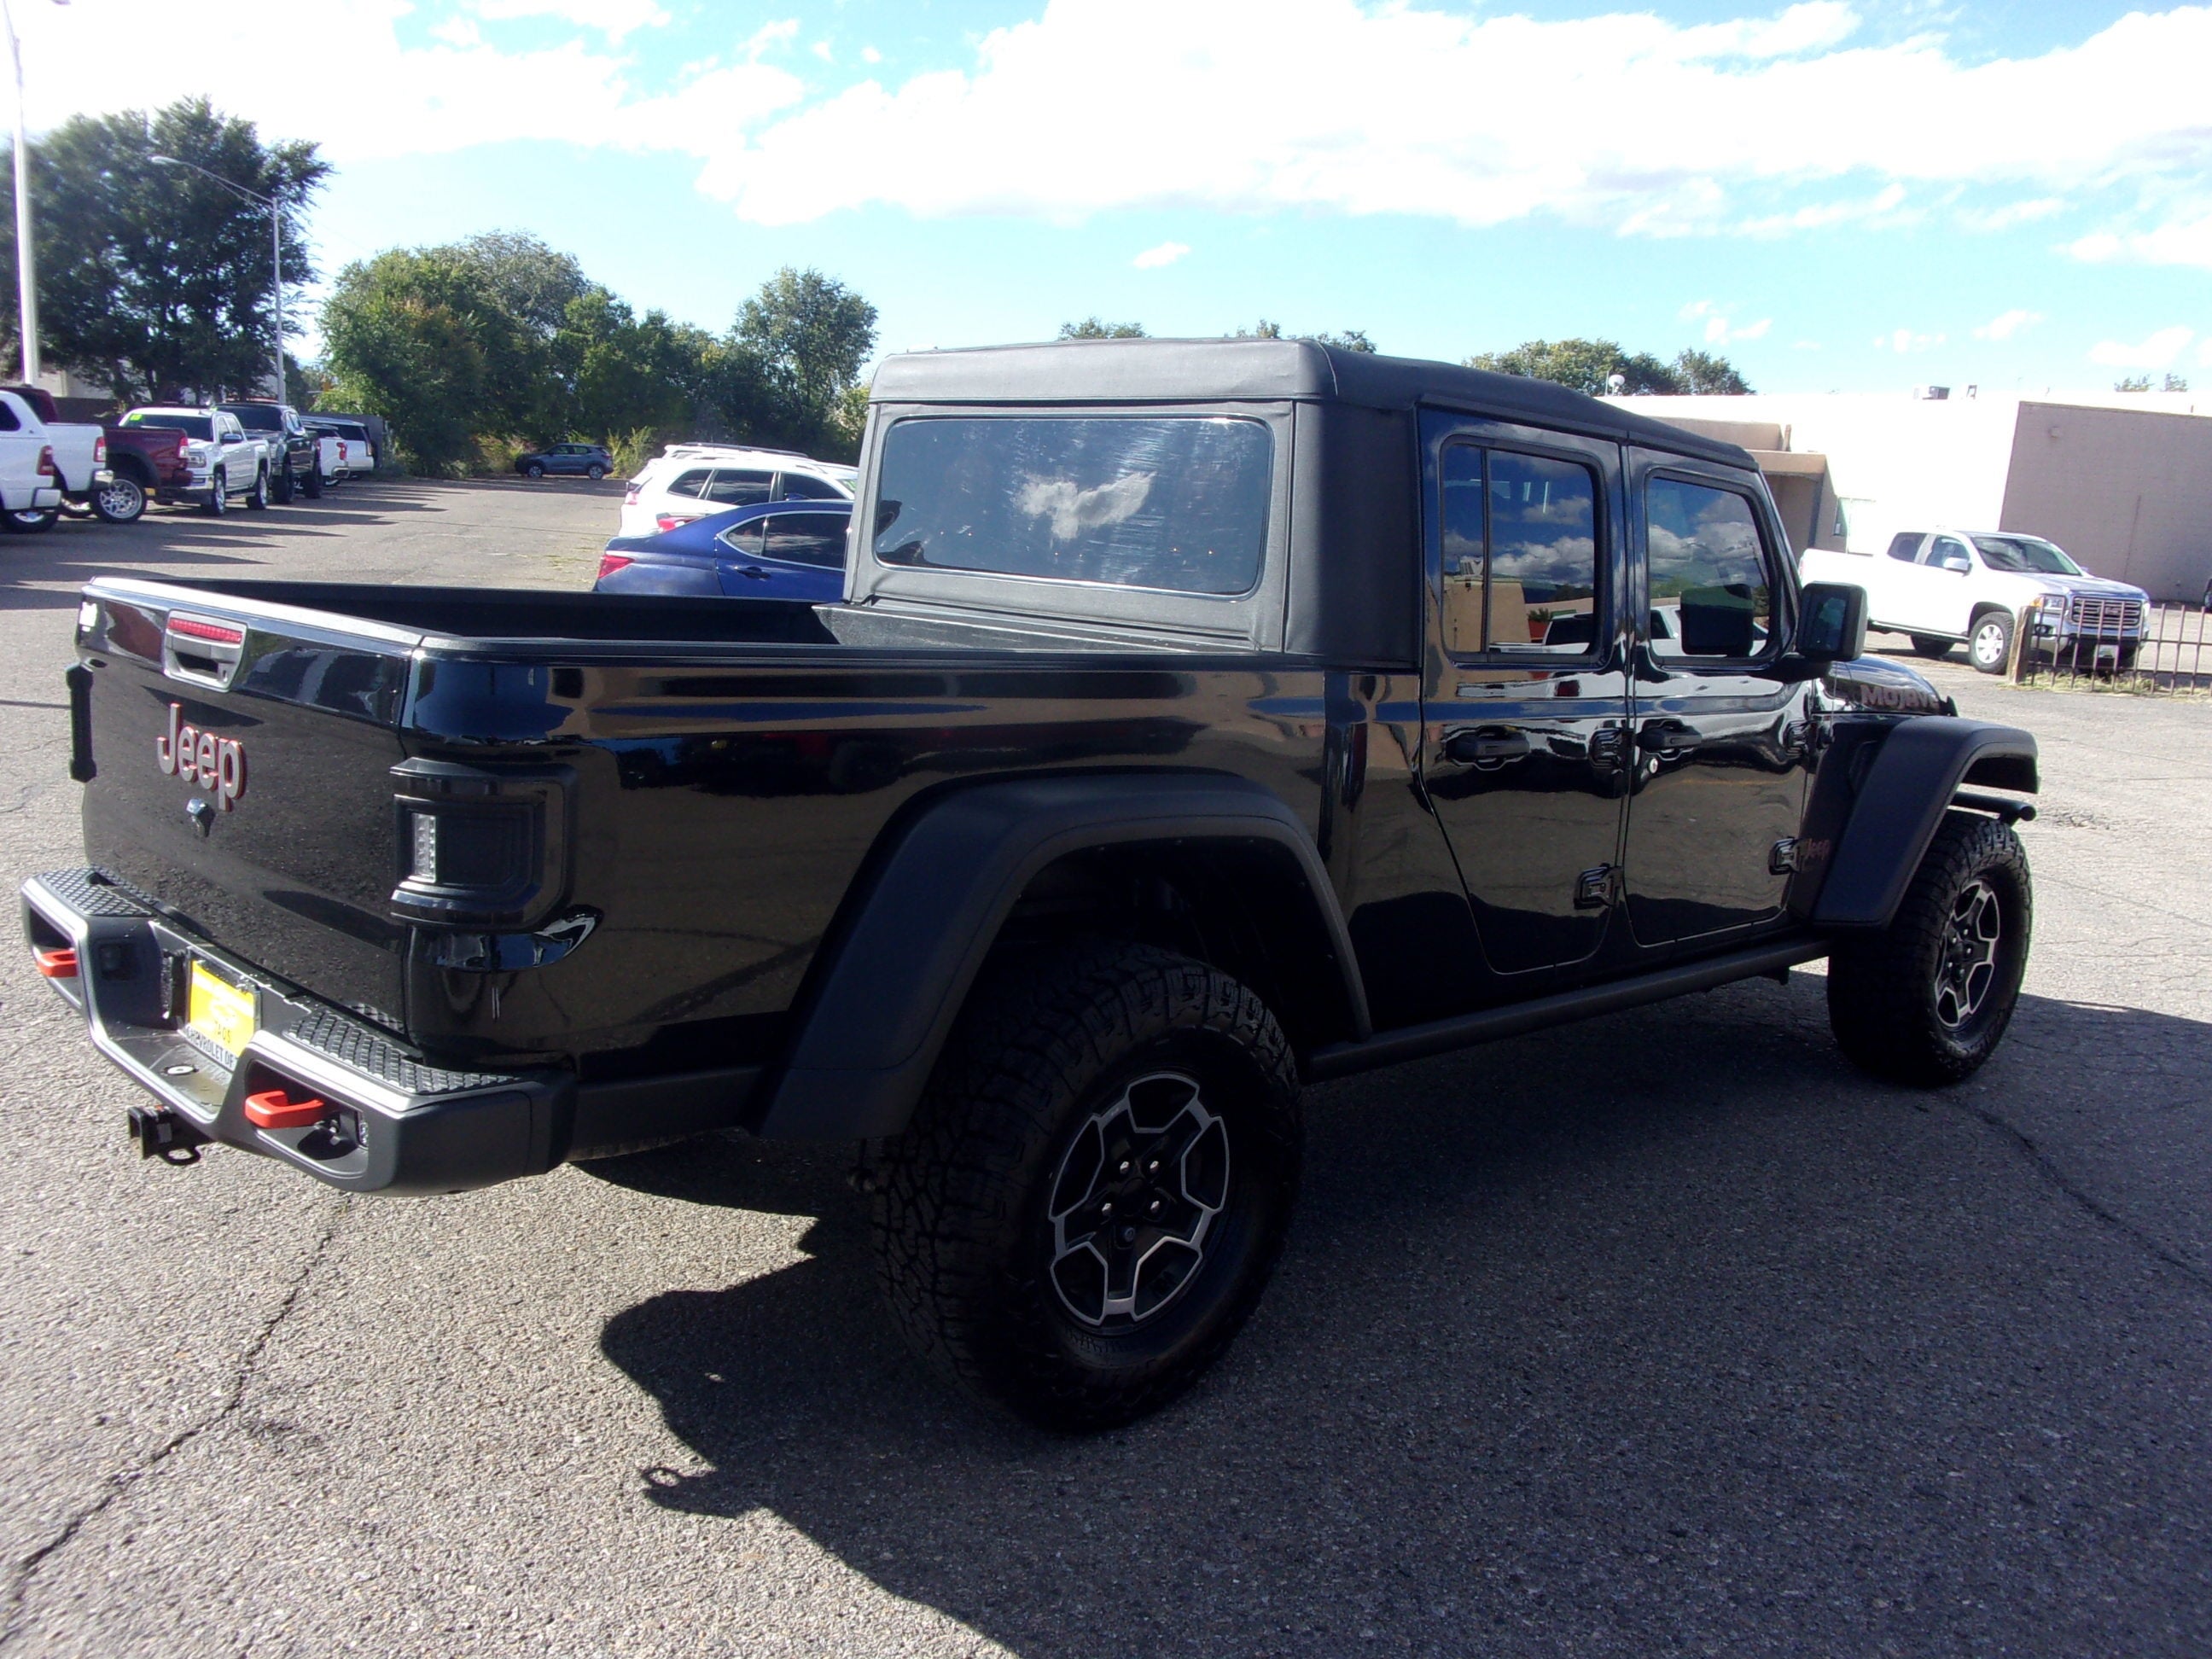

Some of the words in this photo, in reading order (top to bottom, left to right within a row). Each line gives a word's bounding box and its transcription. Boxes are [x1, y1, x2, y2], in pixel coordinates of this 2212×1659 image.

[157, 703, 247, 811] Jeep
[1804, 838, 1831, 861] Jeep
[186, 1026, 224, 1062] CHEVROLET
[224, 1051, 234, 1068] OF
